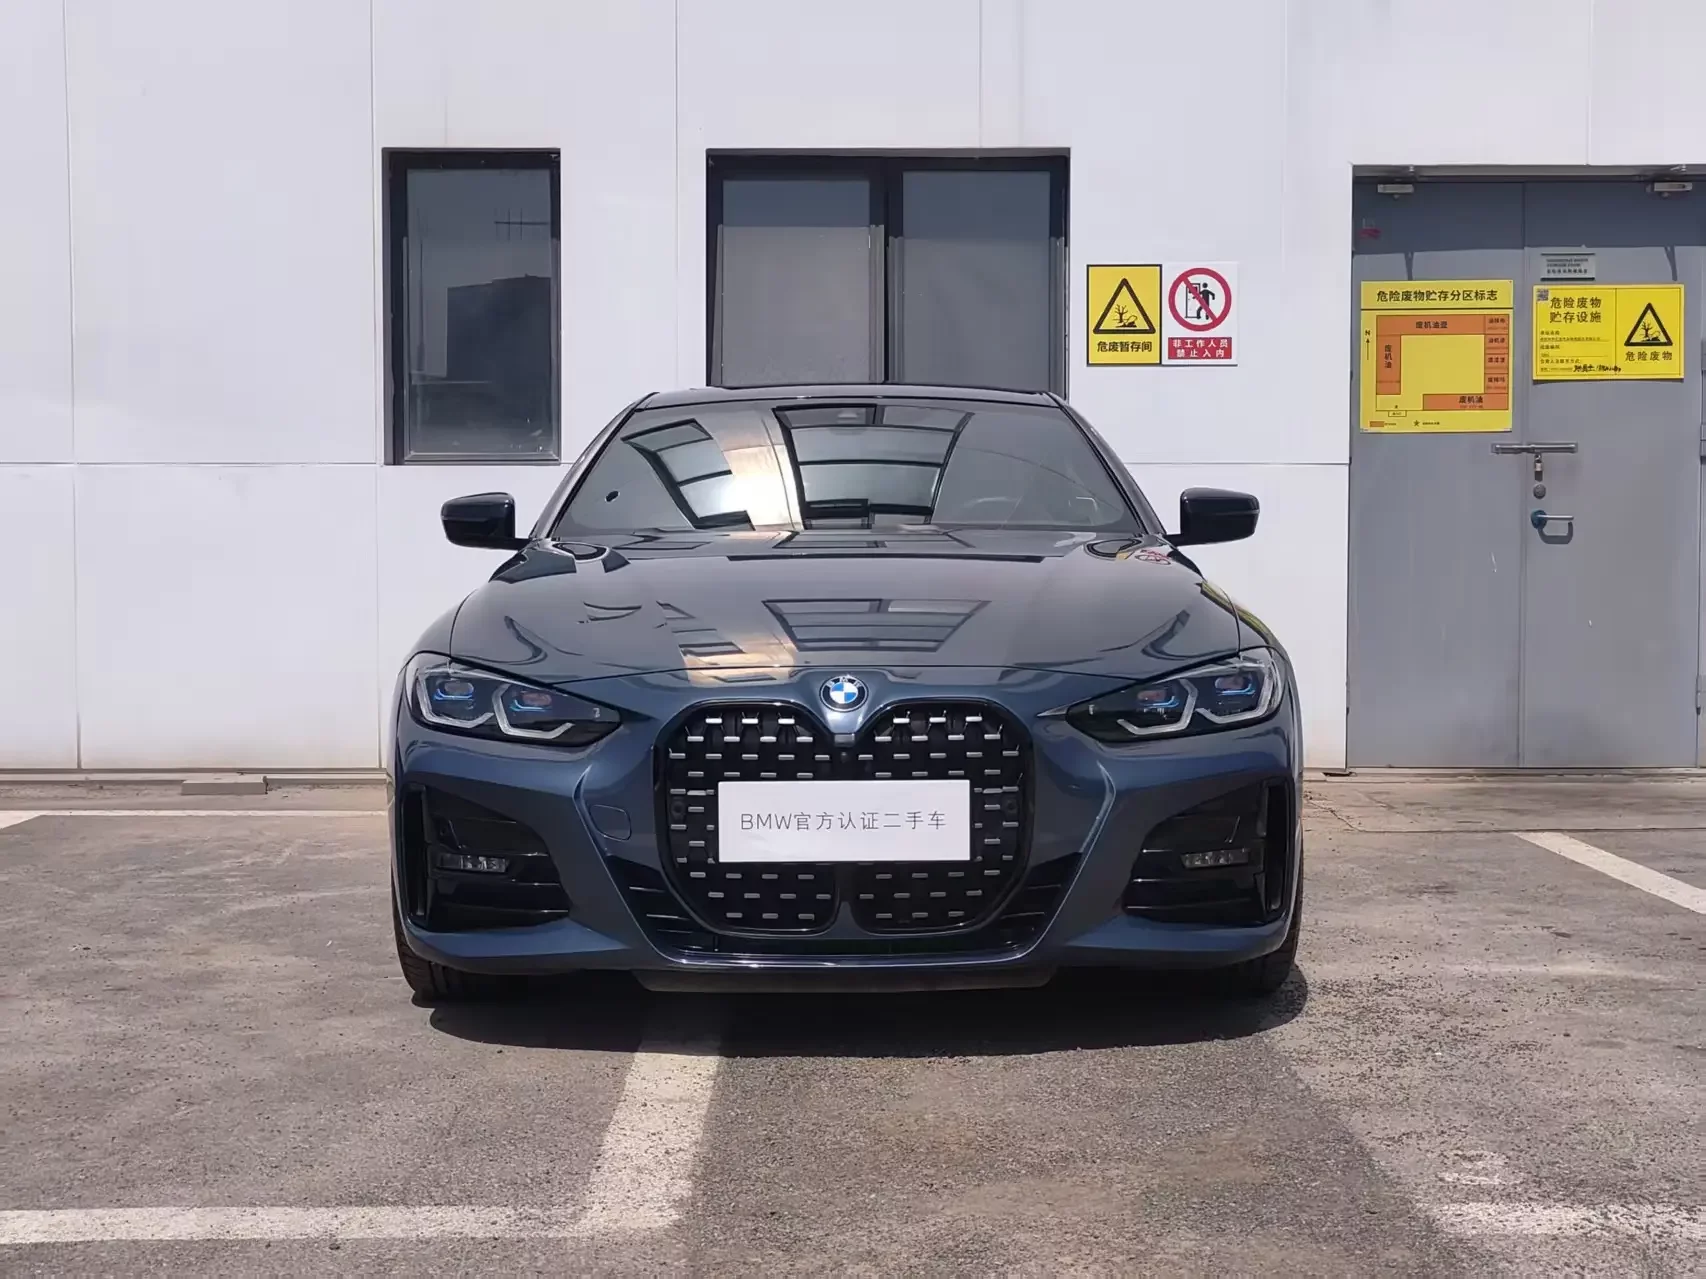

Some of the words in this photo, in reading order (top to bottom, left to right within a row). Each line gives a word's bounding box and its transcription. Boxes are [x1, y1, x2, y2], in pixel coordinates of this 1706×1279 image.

[1376, 289, 1498, 302] 危险废物贮存分区标志
[1550, 296, 1602, 309] 危险废物
[1549, 311, 1602, 324] 贮存设施
[1097, 341, 1153, 353] 危废暂存间
[1172, 339, 1228, 348] 非工作人员
[1176, 348, 1225, 358] 禁止入内
[1625, 350, 1673, 362] 危险废物
[740, 810, 947, 831] BMW官方认证二手车
